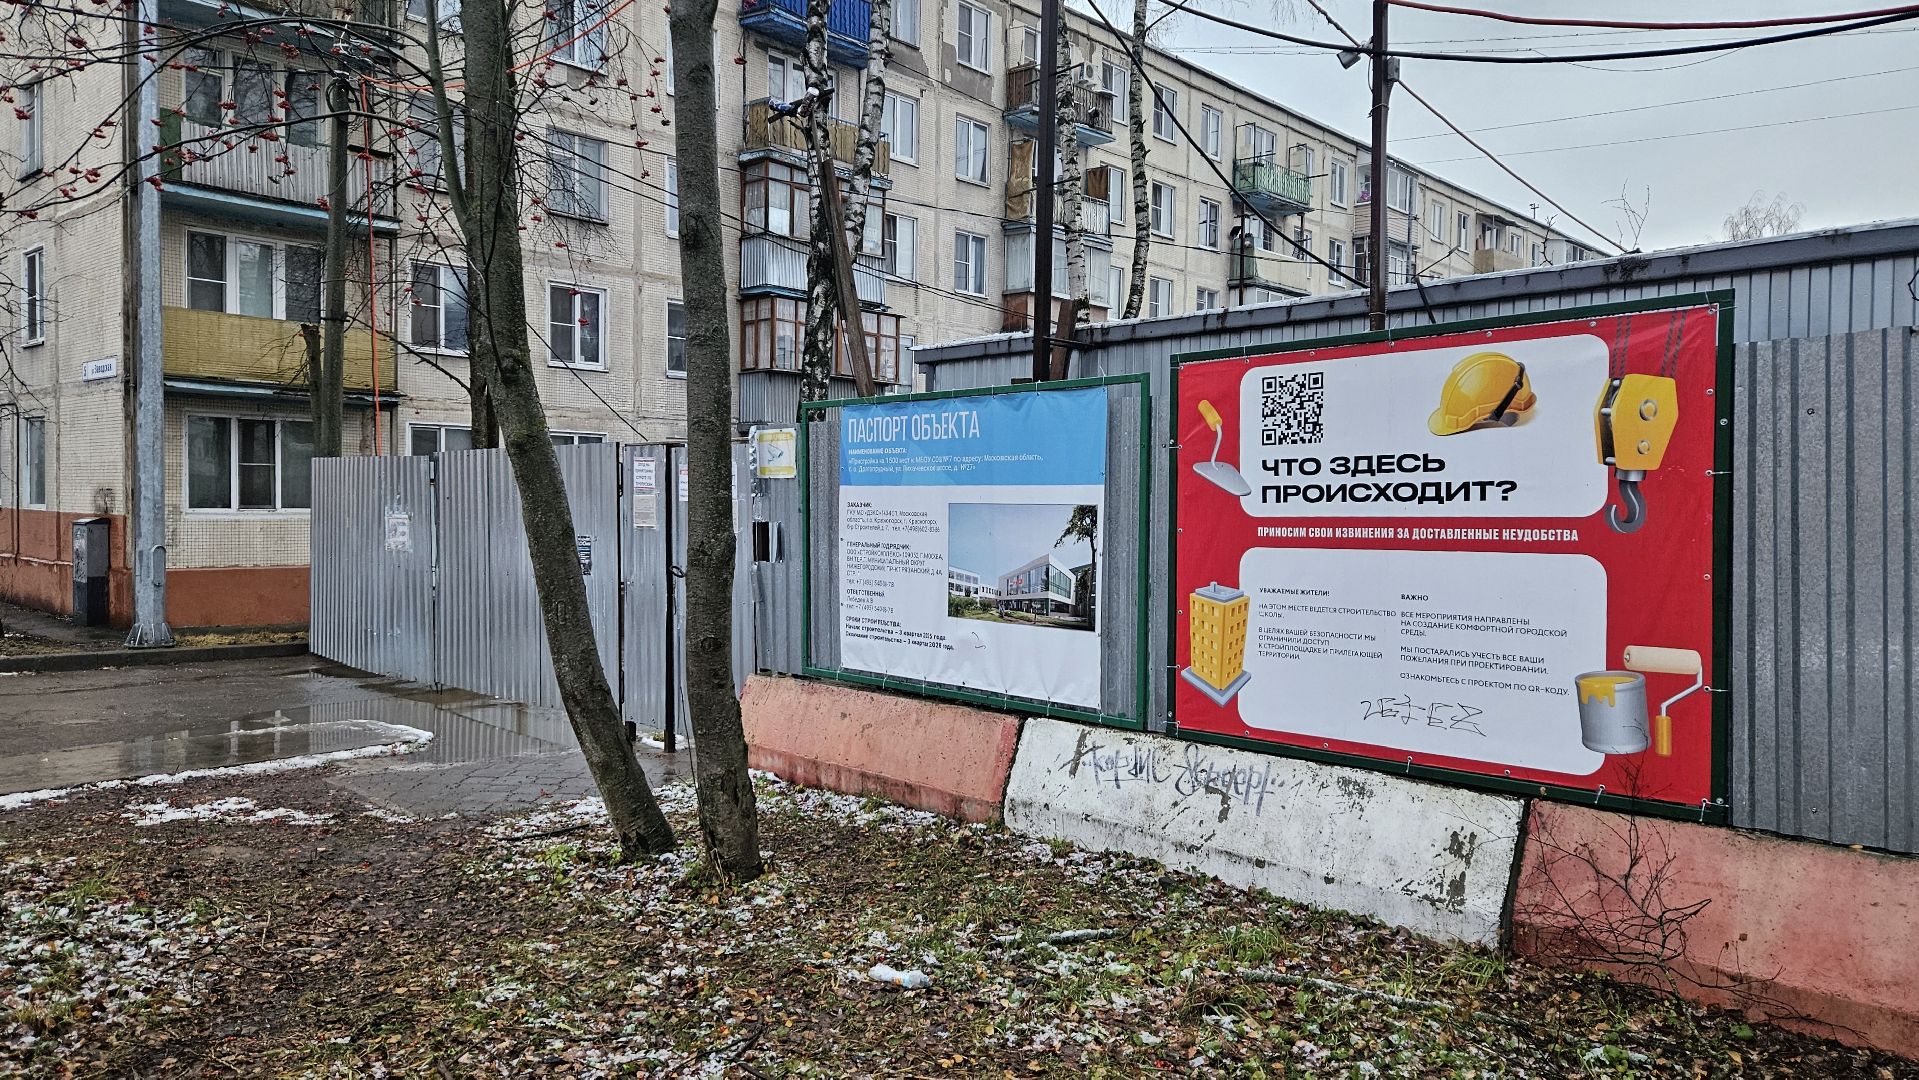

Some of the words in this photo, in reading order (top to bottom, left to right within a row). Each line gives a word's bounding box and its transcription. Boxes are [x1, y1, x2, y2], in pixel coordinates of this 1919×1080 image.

[848, 415, 908, 443] ПАСПОРТ
[911, 410, 980, 441] ОБЪЕКТА
[1262, 457, 1322, 477] ЧТО
[1329, 453, 1446, 477] ЗДЕСЬ
[1262, 481, 1518, 504] ПРОИСХОДИТ?
[1257, 526, 1306, 538] ПРИНОСИМ
[1309, 527, 1333, 539] СВОИ
[1335, 528, 1394, 539] ИЗВИНЕНИЯ
[1397, 528, 1410, 539] ЗА
[1412, 528, 1499, 541] ДОСТАВЛЕННЫЕ
[1502, 529, 1578, 542] НЕУДОБСТВА
[1338, 608, 1396, 617] СТРОИТЕЛЬСТВО
[1416, 612, 1472, 622] МЕРОПРИЯТИЯ
[1474, 616, 1530, 625] НАПРАВЛЕНЫ
[862, 618, 901, 628] СТРОИТЕЛЬСТВА:
[862, 626, 894, 634] строительства
[1412, 620, 1454, 630] СОЗДАНИЕ
[1456, 624, 1514, 634] КОМФОРТНОЙ
[1516, 627, 1568, 637] ГОРОДСКОЙ
[869, 634, 902, 643] строительства
[1259, 635, 1301, 644] ОГРАНИЧИЛИ
[1309, 631, 1362, 640] БЕЗОПАСНОСТИ
[1401, 629, 1427, 637] СРЕДЫ.
[1263, 643, 1321, 654] СТРОЙПЛОЩАДКЕ
[1330, 649, 1382, 659] ПРИЛЕГАЮЩЕЙ
[1414, 647, 1470, 658] ПОСТАРАЛИСЬ
[1472, 651, 1500, 660] УЧЕСТЬ
[1519, 656, 1545, 664] ВАШИ
[1400, 655, 1449, 666] ПОЖЕЛАНИЯ
[1450, 659, 1466, 667] ПРИ
[1468, 660, 1549, 674] ПРОЕКТИРОВАНИИ.
[1400, 672, 1459, 685] ОЗНАКОМЬТЕСЬ
[1467, 679, 1512, 690] ПРОЕКТОМ
[1528, 685, 1570, 696] QR-КОДУ.
